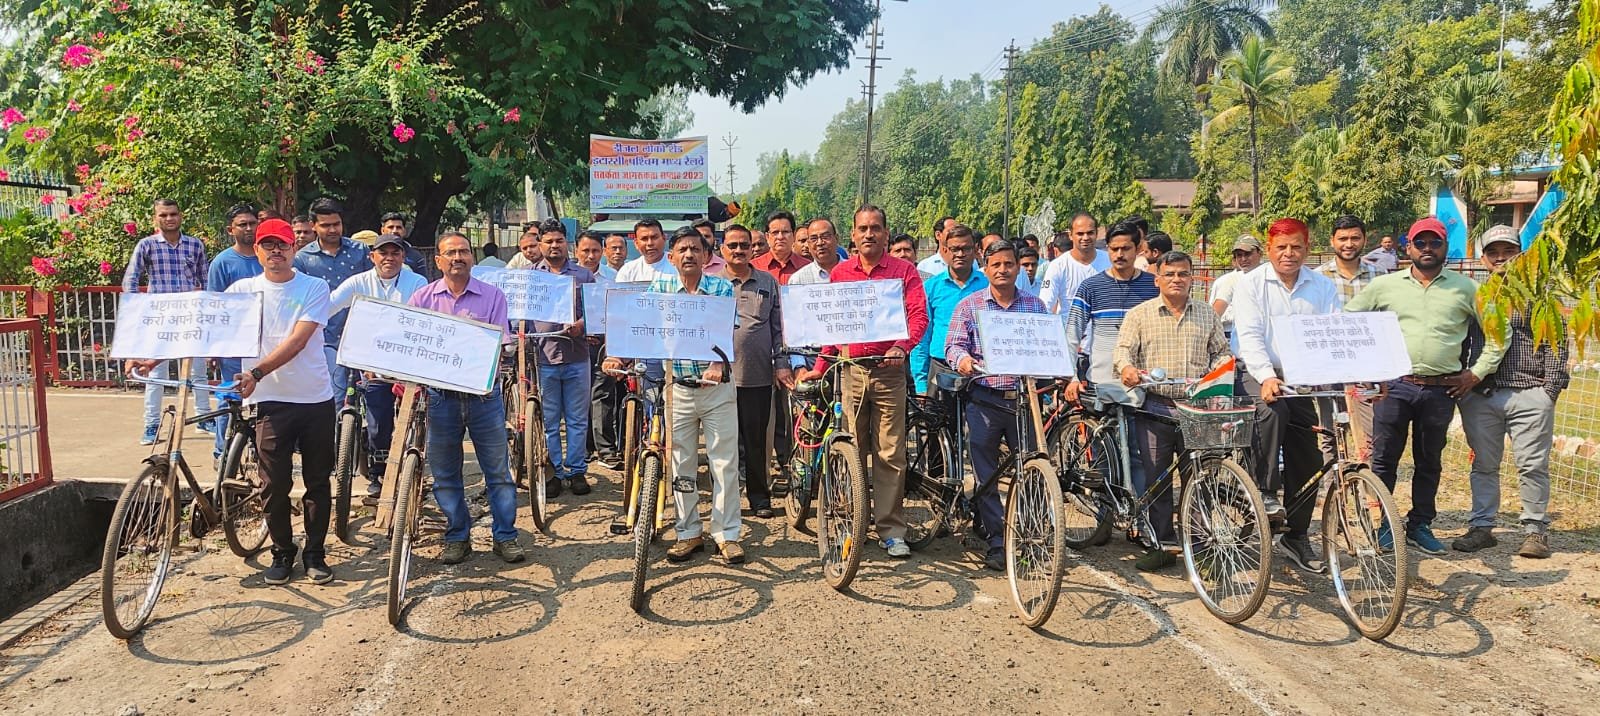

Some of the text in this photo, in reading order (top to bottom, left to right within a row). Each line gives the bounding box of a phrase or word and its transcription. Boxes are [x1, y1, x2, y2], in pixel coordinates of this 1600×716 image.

[682, 171, 704, 180] 2023
[191, 298, 206, 309] पर
[208, 299, 228, 309] वार
[679, 300, 698, 311] लाता
[821, 301, 832, 310] पर
[142, 310, 232, 326] करो अपने देश से
[157, 331, 180, 342] प्यार
[677, 328, 697, 338] लाता
[416, 345, 450, 364] मिटाना
